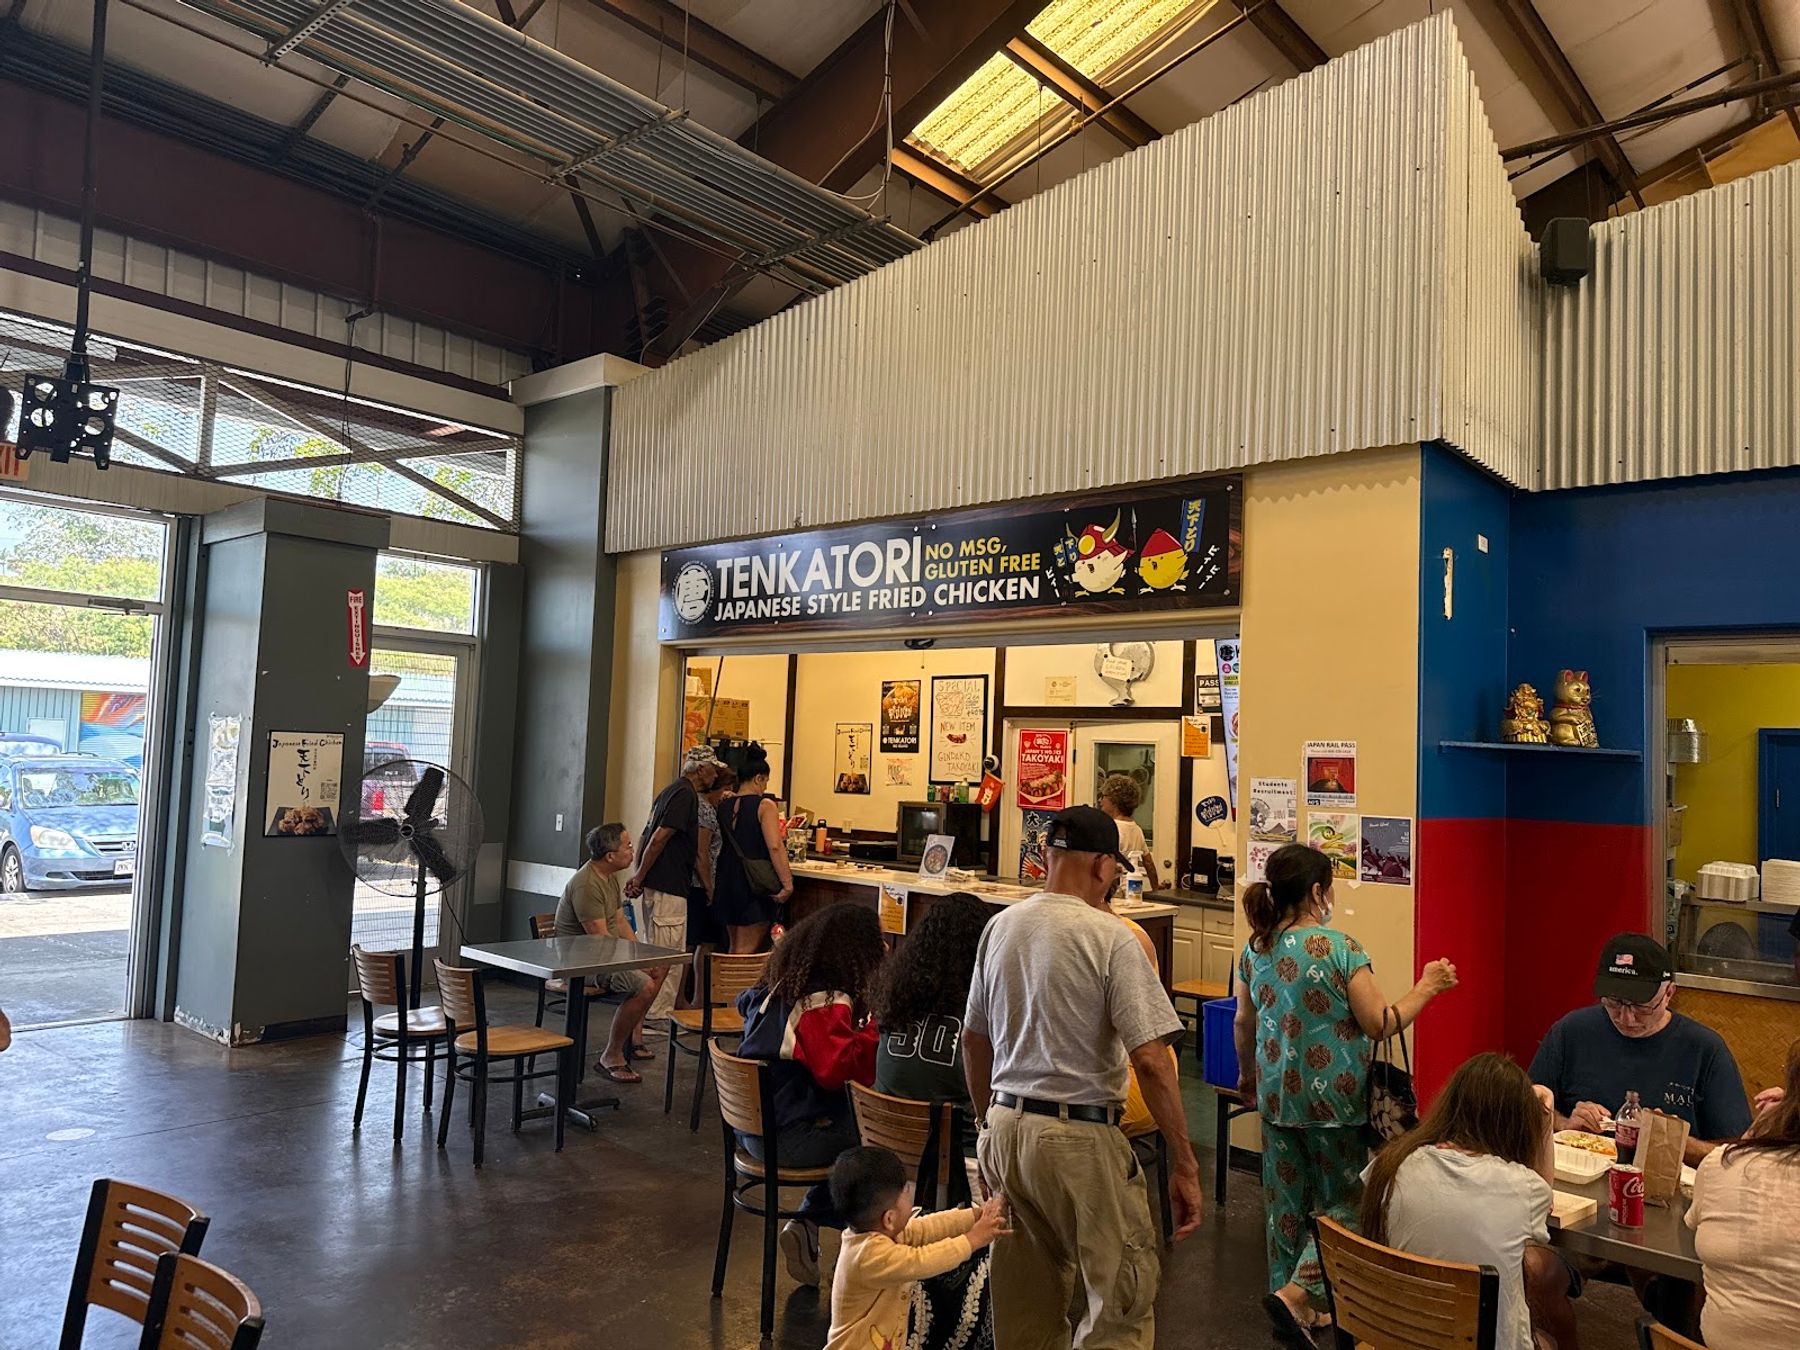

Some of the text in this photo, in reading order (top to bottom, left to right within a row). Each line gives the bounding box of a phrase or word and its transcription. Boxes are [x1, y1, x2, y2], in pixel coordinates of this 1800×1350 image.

[925, 536, 1008, 560] NO MSG,
[716, 536, 922, 600] TENKATORI
[924, 552, 1041, 580] GLUTEN FREE
[714, 576, 1040, 622] JAPANESE STYLE FRIED CHICKEN
[940, 721, 976, 733] NEW ITEM
[272, 739, 342, 748] Japanese Fried Chicken
[1021, 753, 1064, 764] TAKOYAKI
[1253, 788, 1293, 796] Recruitment
[1608, 965, 1639, 976] america.
